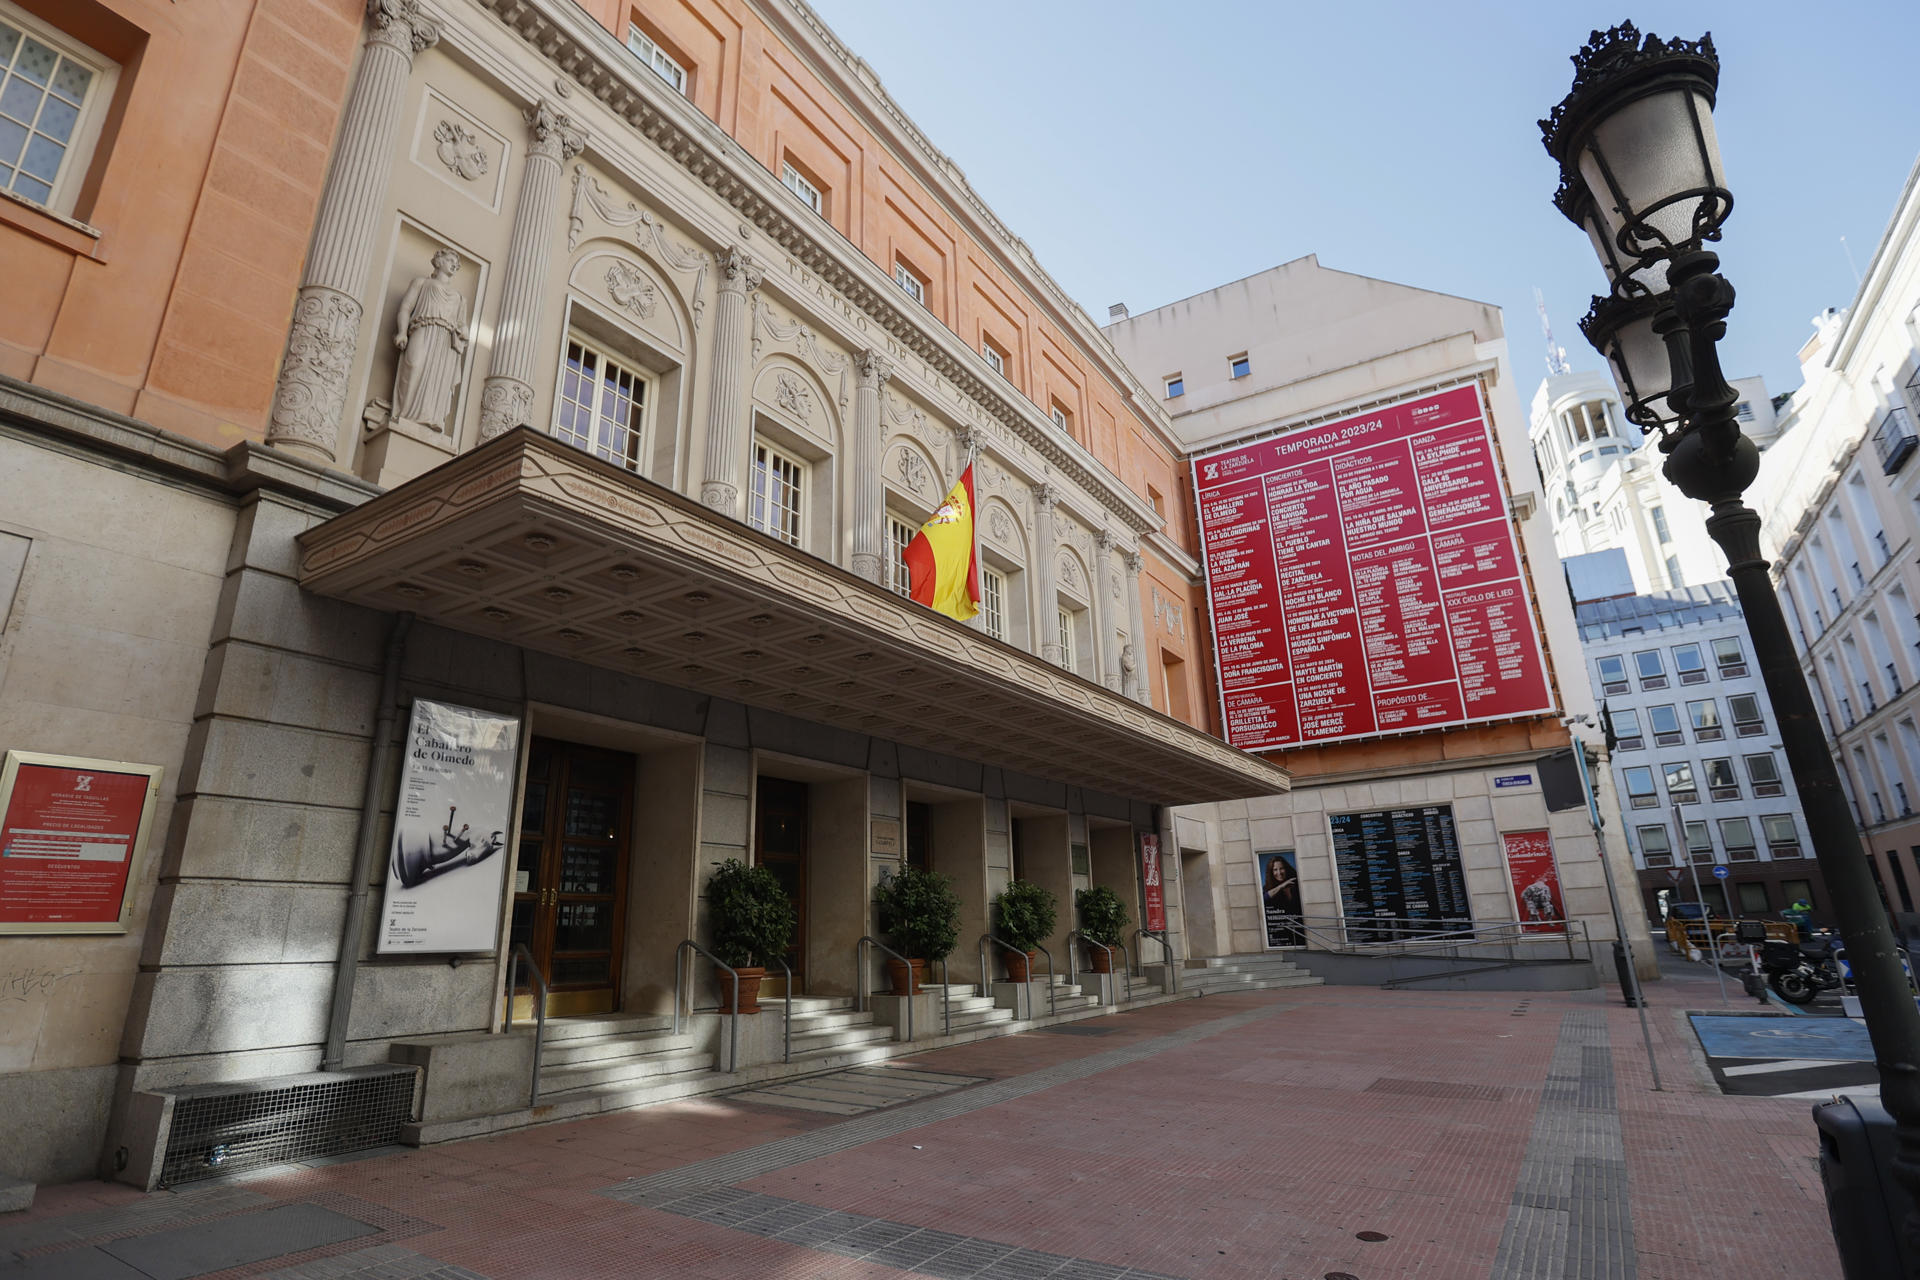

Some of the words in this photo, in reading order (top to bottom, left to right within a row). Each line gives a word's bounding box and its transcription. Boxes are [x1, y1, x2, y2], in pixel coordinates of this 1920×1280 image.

[786, 257, 868, 332] TEATRO
[887, 338, 907, 362] DE
[923, 367, 942, 391] LA
[957, 394, 1027, 457] ZARZUELA
[1274, 431, 1339, 456] TEMPORADA
[1340, 419, 1383, 439] 2023/24
[1412, 434, 1435, 445] DANZA
[1426, 446, 1459, 459] SYLPHIDE
[1220, 456, 1239, 465] TEATRO
[1228, 457, 1254, 468] ZARZUELA
[1335, 454, 1372, 470] DIDÁCTICOS
[1266, 469, 1302, 483] CONCIERTOS
[1421, 476, 1439, 485] GALA
[1268, 486, 1292, 497] HONRAR
[1302, 480, 1317, 488] VIDA
[1348, 481, 1361, 490] AÑO
[1363, 475, 1388, 486] PASADO
[1423, 477, 1469, 492] ANIVERSARIO
[1201, 489, 1220, 499] LÍRICA
[1340, 490, 1354, 498] POR
[1355, 486, 1373, 495] AGUA
[1211, 499, 1243, 512] CABALLERO
[1271, 502, 1304, 515] CONCIERTO
[1428, 500, 1481, 517] GENERACIONES
[1213, 507, 1236, 518] OLMEDO
[1281, 508, 1307, 519] NAVIDAD
[1354, 517, 1371, 526] NIÑA
[1372, 514, 1385, 522] QUE
[1386, 506, 1416, 519] SALVARÁ
[1219, 524, 1260, 538] GOLONDRINAS
[1346, 523, 1376, 535] NUESTRO
[1378, 518, 1403, 528] MUNDO
[1277, 546, 1294, 555] TIENE
[1305, 539, 1330, 549] CANTAR
[1285, 536, 1308, 546] PUEBLO
[1434, 535, 1464, 549] CÁMARA
[1351, 551, 1373, 561] NOTAS
[1374, 548, 1387, 556] DEL
[1387, 541, 1415, 554] AMBIGÚ
[1219, 557, 1234, 565] ROSA
[1223, 560, 1250, 572] AZAFRÁN
[1280, 569, 1304, 578] RECITAL
[1291, 572, 1322, 583] ZARZUELA
[1284, 596, 1305, 605] NOCHE
[1316, 589, 1342, 599] BLANCO
[1446, 597, 1461, 606] XXX
[1462, 593, 1484, 603] CICLO
[1484, 591, 1496, 599] DE
[1496, 588, 1514, 597] LIED
[1217, 615, 1232, 623] JUAN
[1233, 611, 1248, 620] JOSÉ
[1287, 613, 1320, 624] HOMENAJE
[1326, 607, 1354, 617] VICTORIA
[1310, 616, 1338, 628] ÁNGELES
[1228, 635, 1256, 645] VERBENA
[1291, 636, 1315, 647] MÚSICA
[1316, 629, 1351, 643] SINFÓNICA
[1238, 641, 1264, 650] PALOMA
[1292, 642, 1325, 655] ESPAÑOLA
[1223, 668, 1240, 678] DOÑA
[1241, 663, 1283, 675] FRANCISQUITA
[1295, 667, 1316, 676] MAYTE
[1317, 661, 1342, 672] MARTÍN
[1305, 671, 1342, 682] CONCIERTO
[1298, 691, 1312, 699] UNA
[1313, 688, 1335, 697] NOCHE
[1376, 693, 1417, 706] PROPÓSITO
[1236, 694, 1262, 706] CÁMARA
[1299, 696, 1332, 707] ZARZUELA
[1230, 715, 1262, 726] GRILLETTA
[1231, 721, 1276, 732] PORSUGNACCO
[1302, 719, 1319, 728] JOSÉ
[1320, 716, 1343, 726] MERCÉ
[416, 723, 430, 735] El
[413, 748, 428, 760] de
[431, 750, 475, 766] Olmedo
[1330, 816, 1351, 824] 23/24
